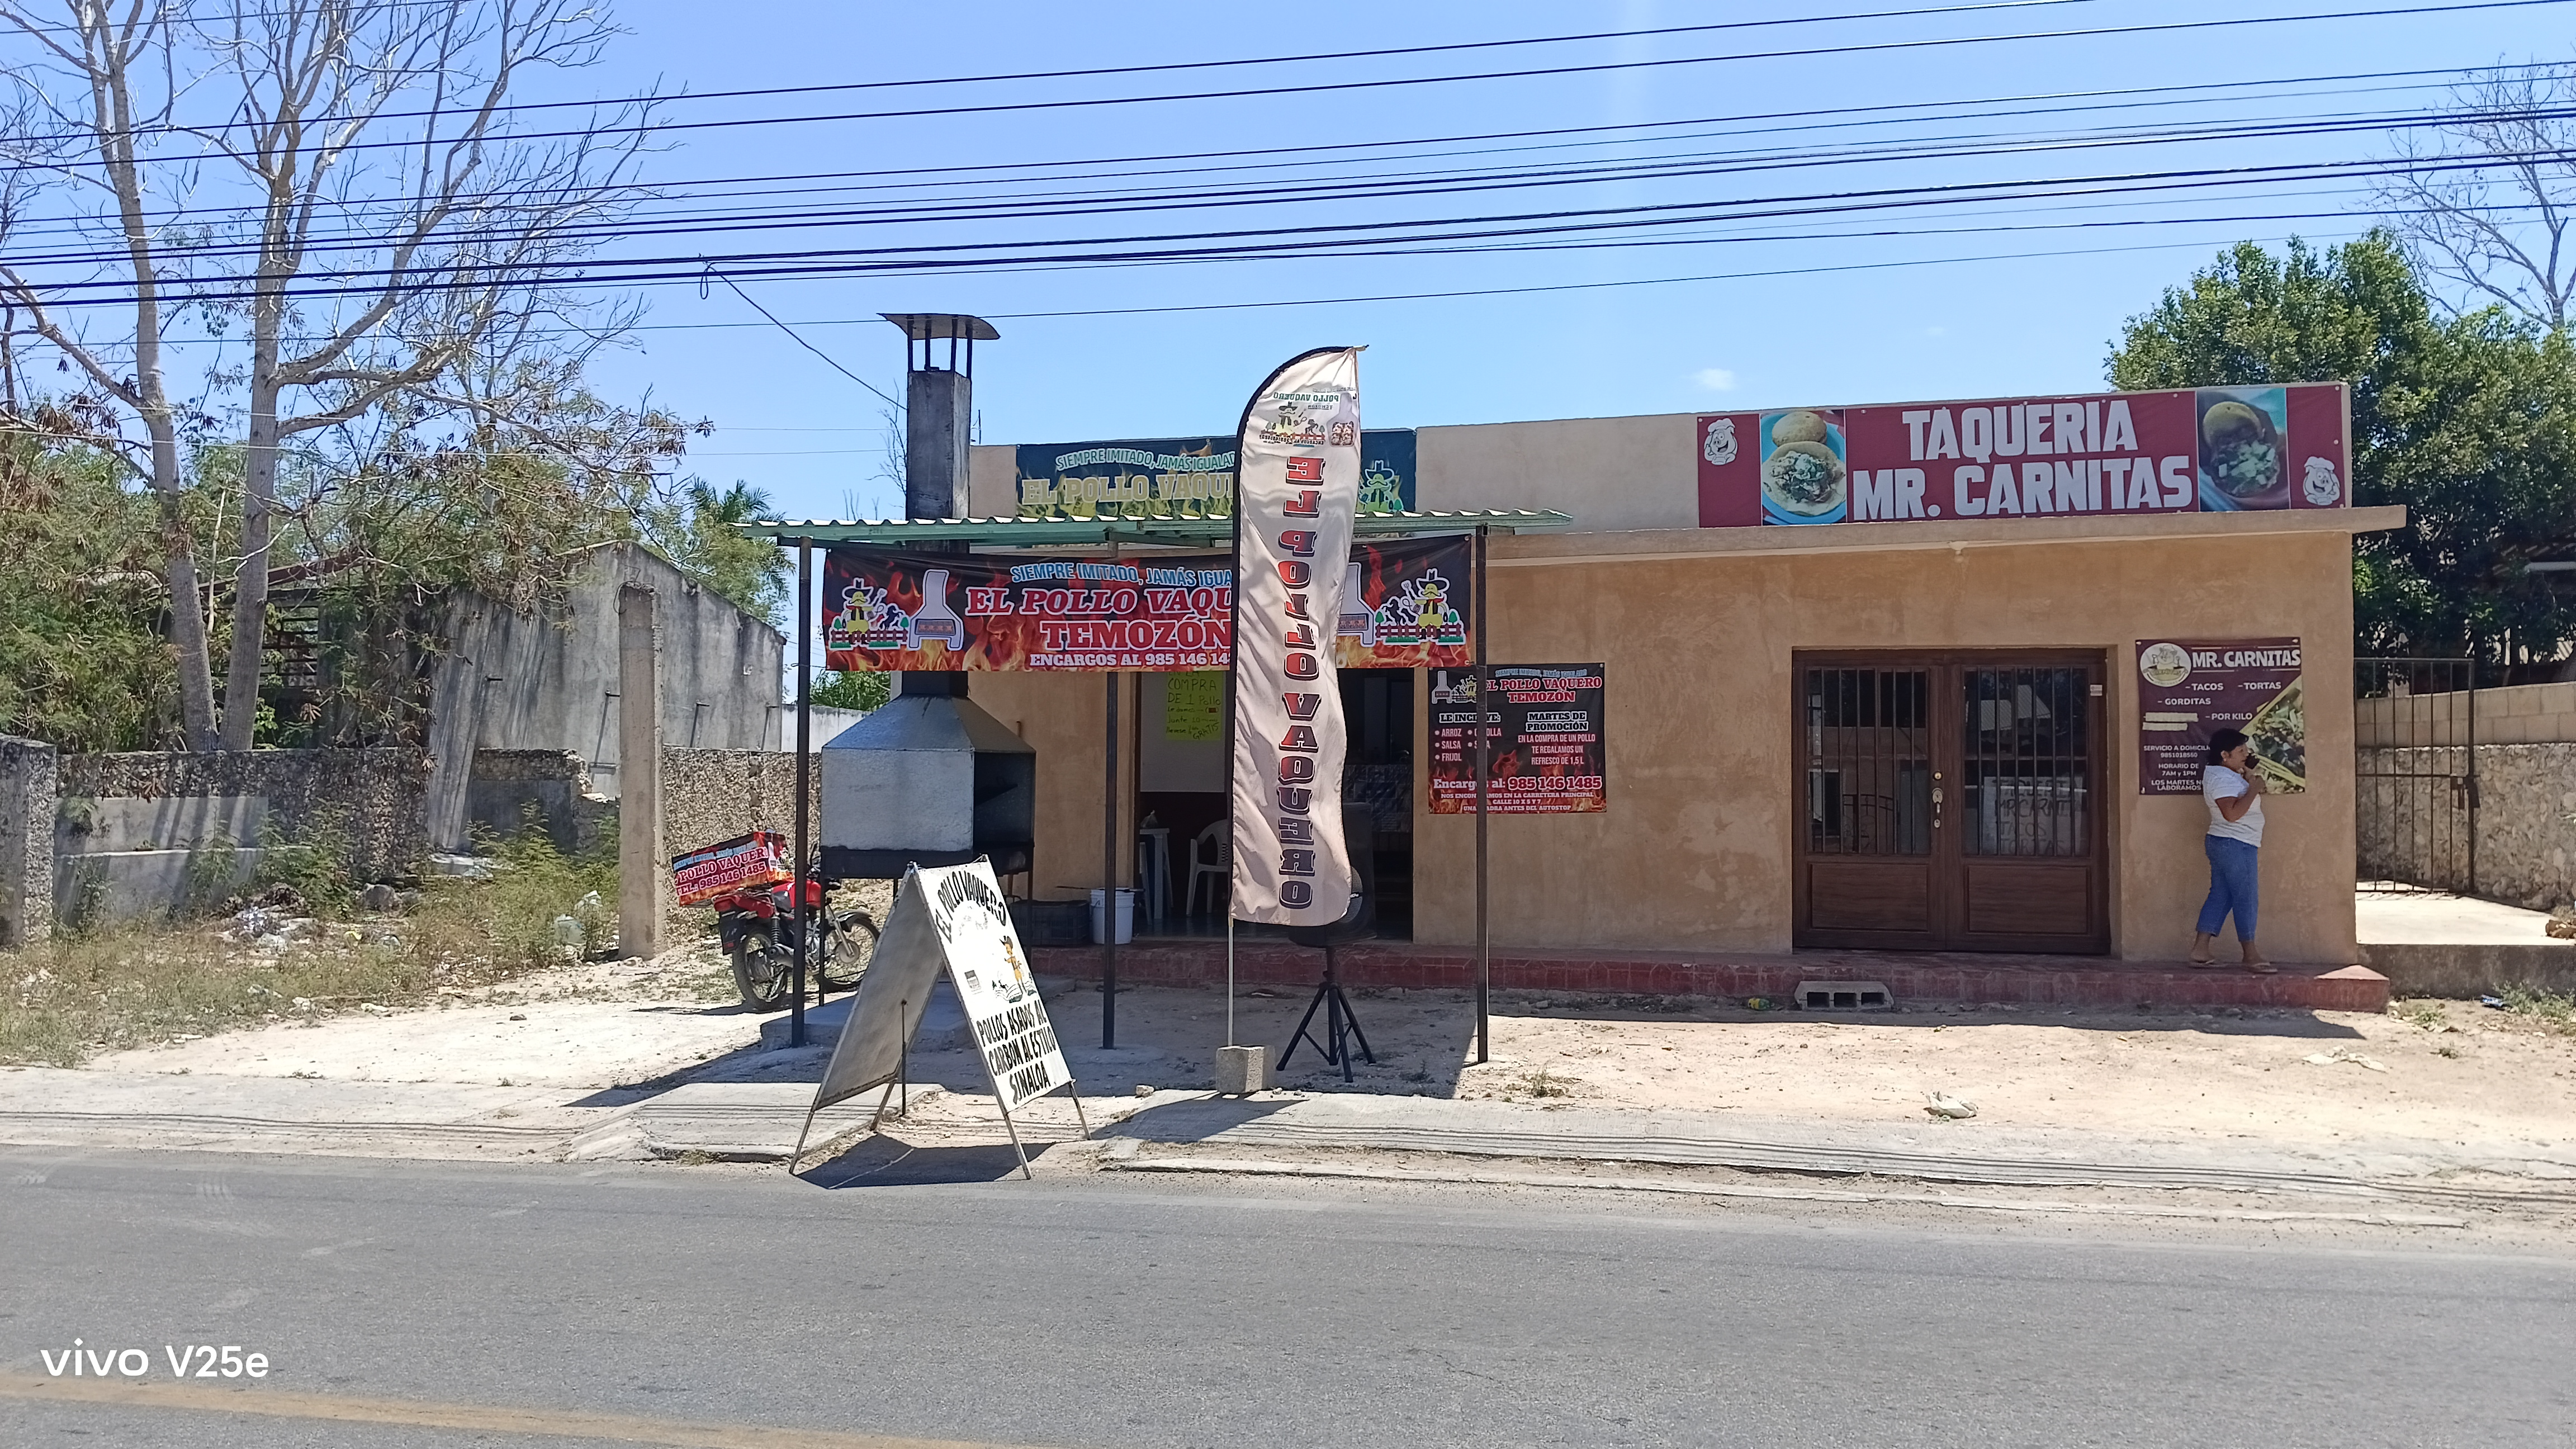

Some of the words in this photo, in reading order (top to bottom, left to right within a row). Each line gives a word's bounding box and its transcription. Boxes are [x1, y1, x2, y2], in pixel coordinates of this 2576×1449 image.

[1902, 399, 2138, 464] TAQUERIA
[1055, 449, 1105, 471] SIEMPRE
[1106, 448, 1156, 470] IMITADO,
[1156, 453, 1192, 472] JAMÁS
[1192, 451, 1235, 472] IGUALAD
[1022, 479, 1058, 505] EL
[1063, 475, 1149, 503] POLLO
[1156, 472, 1233, 501] VAQU
[1853, 468, 1942, 520] MR.
[1954, 456, 2193, 515] CARNITAS
[1010, 562, 1074, 583] SIEMPRE
[1077, 562, 1144, 586] IMITADO,
[1147, 566, 1196, 586] JAMÁS
[1198, 569, 1232, 587] IGUA
[965, 586, 1015, 615] EL
[1019, 588, 1139, 615] POLLO
[1144, 587, 1232, 618] VAQU
[1040, 617, 1231, 651] TEMOZÓN
[1030, 654, 1117, 666] ENCARGOS
[1120, 654, 1142, 666] AL
[1145, 653, 1175, 666] 985
[1179, 653, 1207, 665] 146
[1210, 653, 1230, 665] 14
[2192, 651, 2222, 667] MR.
[2224, 650, 2302, 667] CARNITAS
[1168, 678, 1217, 692] COMPRA
[1500, 679, 1541, 690] POLLO
[1543, 676, 1603, 690] VAQUERO
[1167, 692, 1182, 704] DE
[1186, 694, 1195, 705] 1
[1199, 695, 1221, 705] Pollo
[1507, 690, 1576, 703] TEMOZÓN
[1527, 721, 1588, 731] PROMOCIÓN
[1528, 712, 1570, 721] MARTES
[1572, 712, 1586, 720] DE
[1442, 728, 1462, 737] ARROZ
[1442, 741, 1461, 749] SALSA
[1540, 745, 1574, 754] REGALAMOS
[1442, 753, 1462, 761] FRIJOL
[1491, 778, 1505, 788] al:
[1508, 777, 1536, 790] 985
[1538, 776, 1565, 790] 146
[1566, 776, 1602, 789] 1485
[679, 861, 717, 884] POLLO
[699, 875, 721, 890] 985
[721, 870, 741, 884] 146
[741, 861, 768, 878] 1485
[937, 871, 964, 921] POLLO
[958, 870, 1007, 927] VAQUERO
[935, 908, 953, 945] EL
[976, 1013, 1008, 1048] POLLOS
[1006, 1003, 1035, 1036] ASADOS
[1034, 999, 1047, 1026] AL
[988, 1038, 1024, 1077] CARBON
[1020, 1034, 1034, 1063] AL
[1029, 1026, 1057, 1058] ESTILO
[1009, 1060, 1051, 1105] SINALOA
